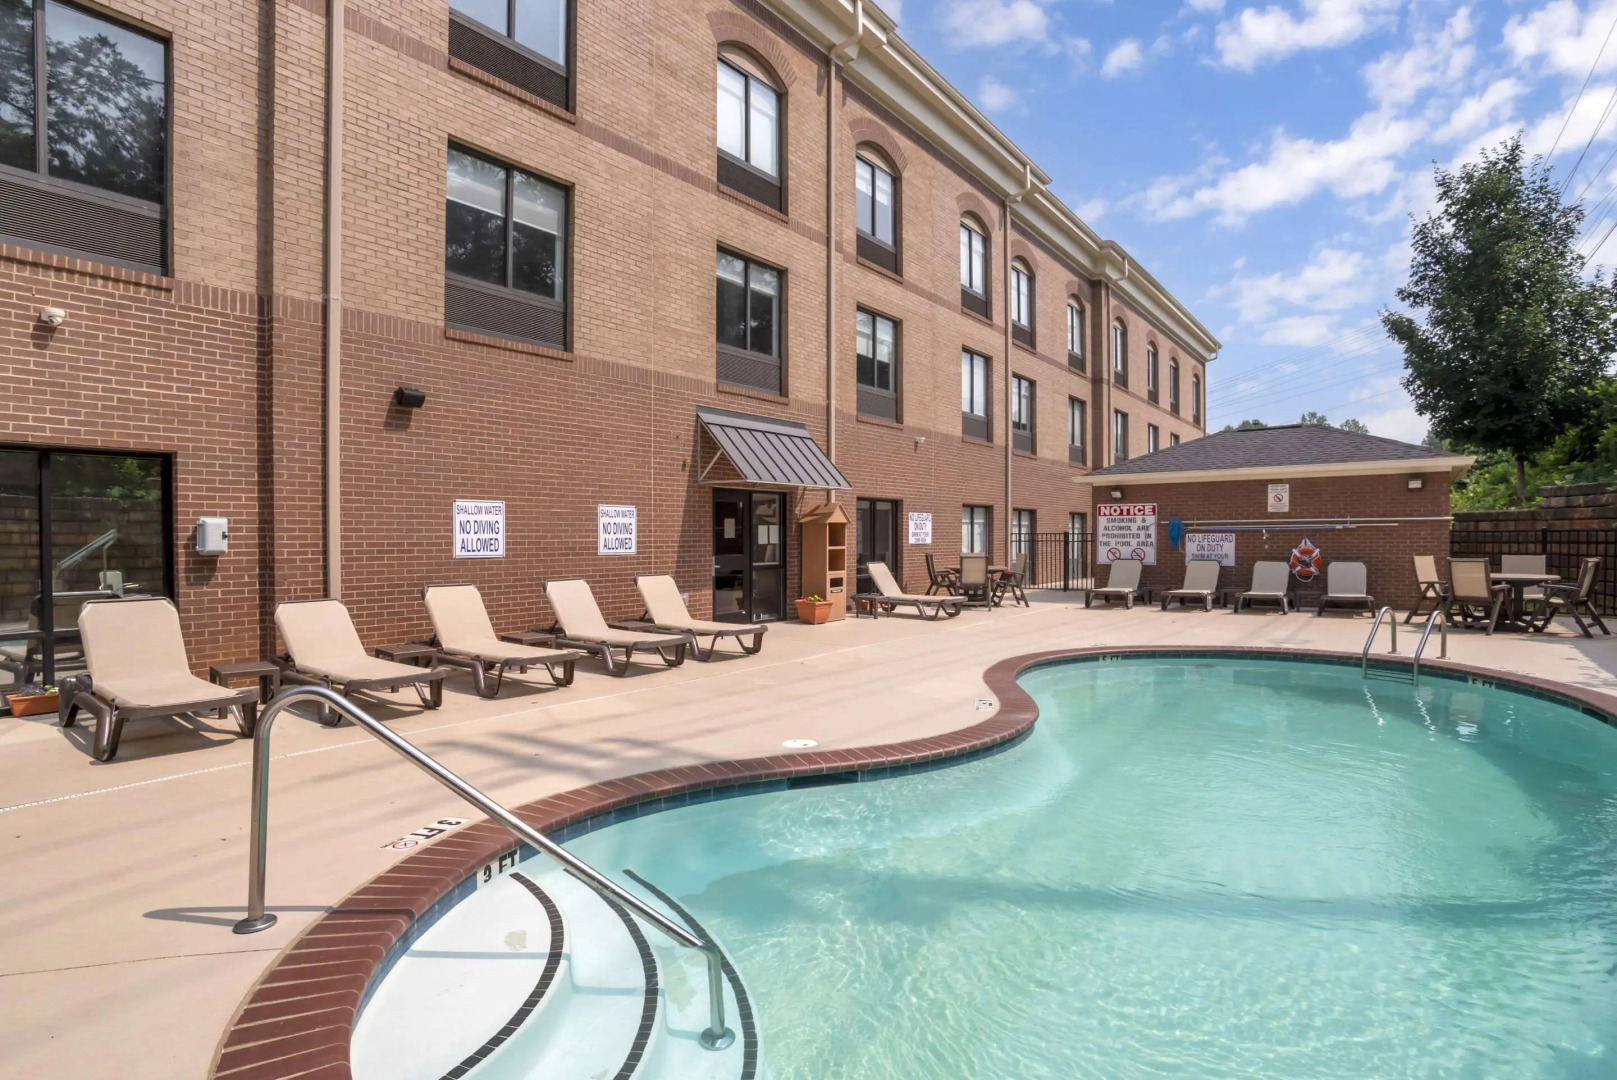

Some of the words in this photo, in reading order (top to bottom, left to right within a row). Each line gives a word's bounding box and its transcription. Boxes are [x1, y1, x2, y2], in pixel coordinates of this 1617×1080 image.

[456, 504, 484, 515] SHALLOW
[484, 505, 502, 516] WATER
[600, 509, 620, 518] SHALLOW
[621, 510, 635, 519] WATER
[1100, 505, 1154, 516] NOTICE
[460, 520, 472, 534] NO
[473, 520, 500, 534] DIVING
[602, 522, 612, 534] NO
[613, 522, 632, 535] DIVING
[603, 537, 632, 550] ALLOWED
[1198, 534, 1233, 543] LIFEGUARD
[460, 538, 500, 552] ALLOWED
[1206, 544, 1224, 552] DUTY
[410, 827, 446, 839] FT
[484, 864, 492, 883] 3
[498, 848, 518, 874] FT
